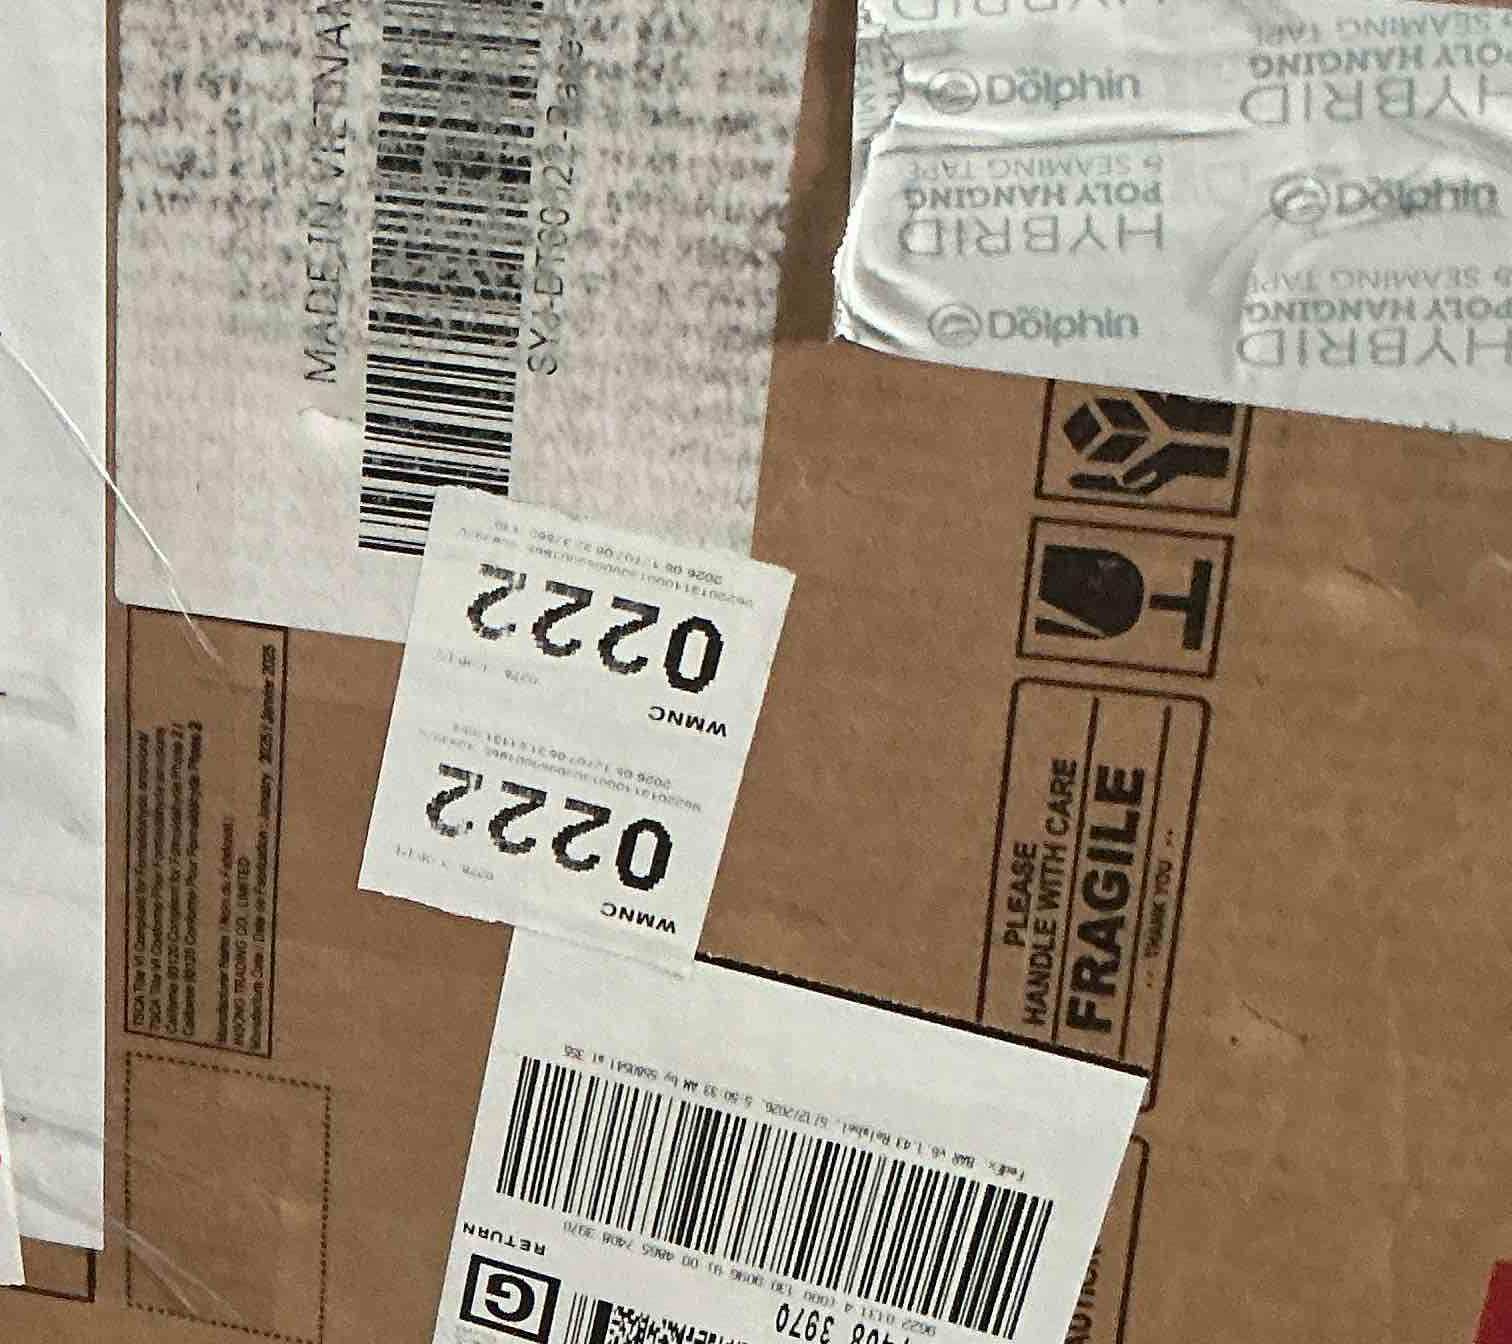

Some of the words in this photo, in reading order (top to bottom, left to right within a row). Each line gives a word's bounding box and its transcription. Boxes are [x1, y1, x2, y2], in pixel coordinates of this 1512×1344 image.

[904, 184, 1065, 210] HANGING
[1076, 181, 1162, 206] POLY
[897, 212, 1163, 255] HYBRID
[467, 563, 723, 693] 0222
[648, 705, 727, 737] WMNC
[426, 763, 673, 892] 0222
[1045, 759, 1077, 835] CARE
[1006, 842, 1037, 946] PLEASE
[1039, 842, 1063, 911] WITH
[1066, 766, 1145, 1032] FRAGILE
[600, 902, 676, 934] WMNC
[1022, 919, 1058, 1025] HANDLE
[459, 1219, 548, 1257] RETURN
